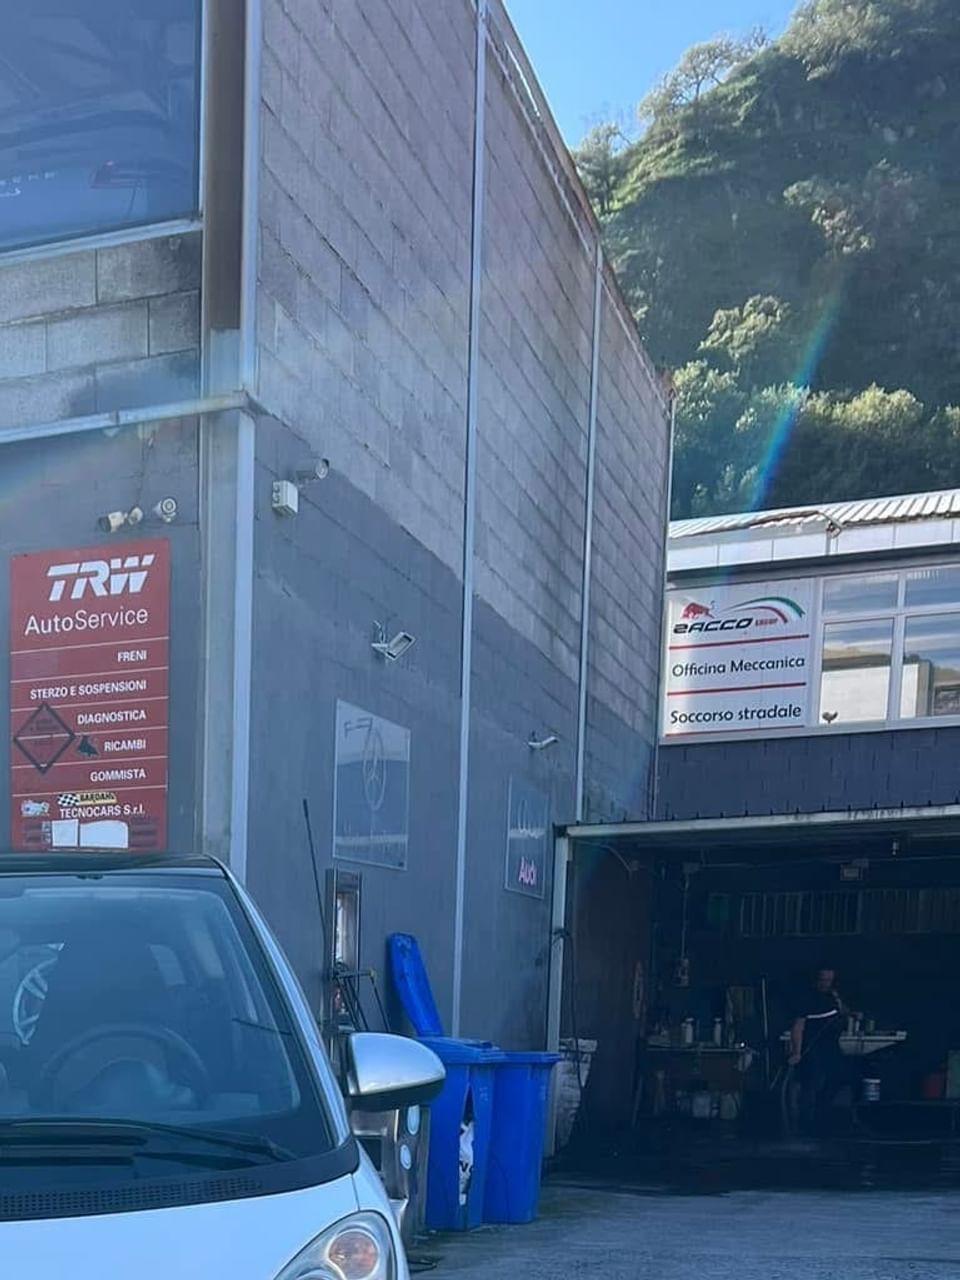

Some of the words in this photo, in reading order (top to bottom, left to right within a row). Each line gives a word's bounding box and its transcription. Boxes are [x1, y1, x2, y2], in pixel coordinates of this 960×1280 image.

[47, 554, 155, 602] TRW
[24, 606, 149, 636] AutoService
[117, 650, 147, 662] FRENI
[672, 662, 726, 677] Officina
[730, 656, 805, 673] Meccanica
[30, 686, 68, 700] STERZO
[70, 684, 77, 696] E
[78, 680, 147, 695] SOSPENSIONI
[77, 709, 147, 725] DIAGNOSTICA
[670, 709, 733, 724] Soccorso
[738, 703, 802, 721] stradale
[104, 738, 146, 752] RICAMBI
[90, 768, 146, 782] GOMMISTA
[60, 805, 121, 819] TECNOCARS
